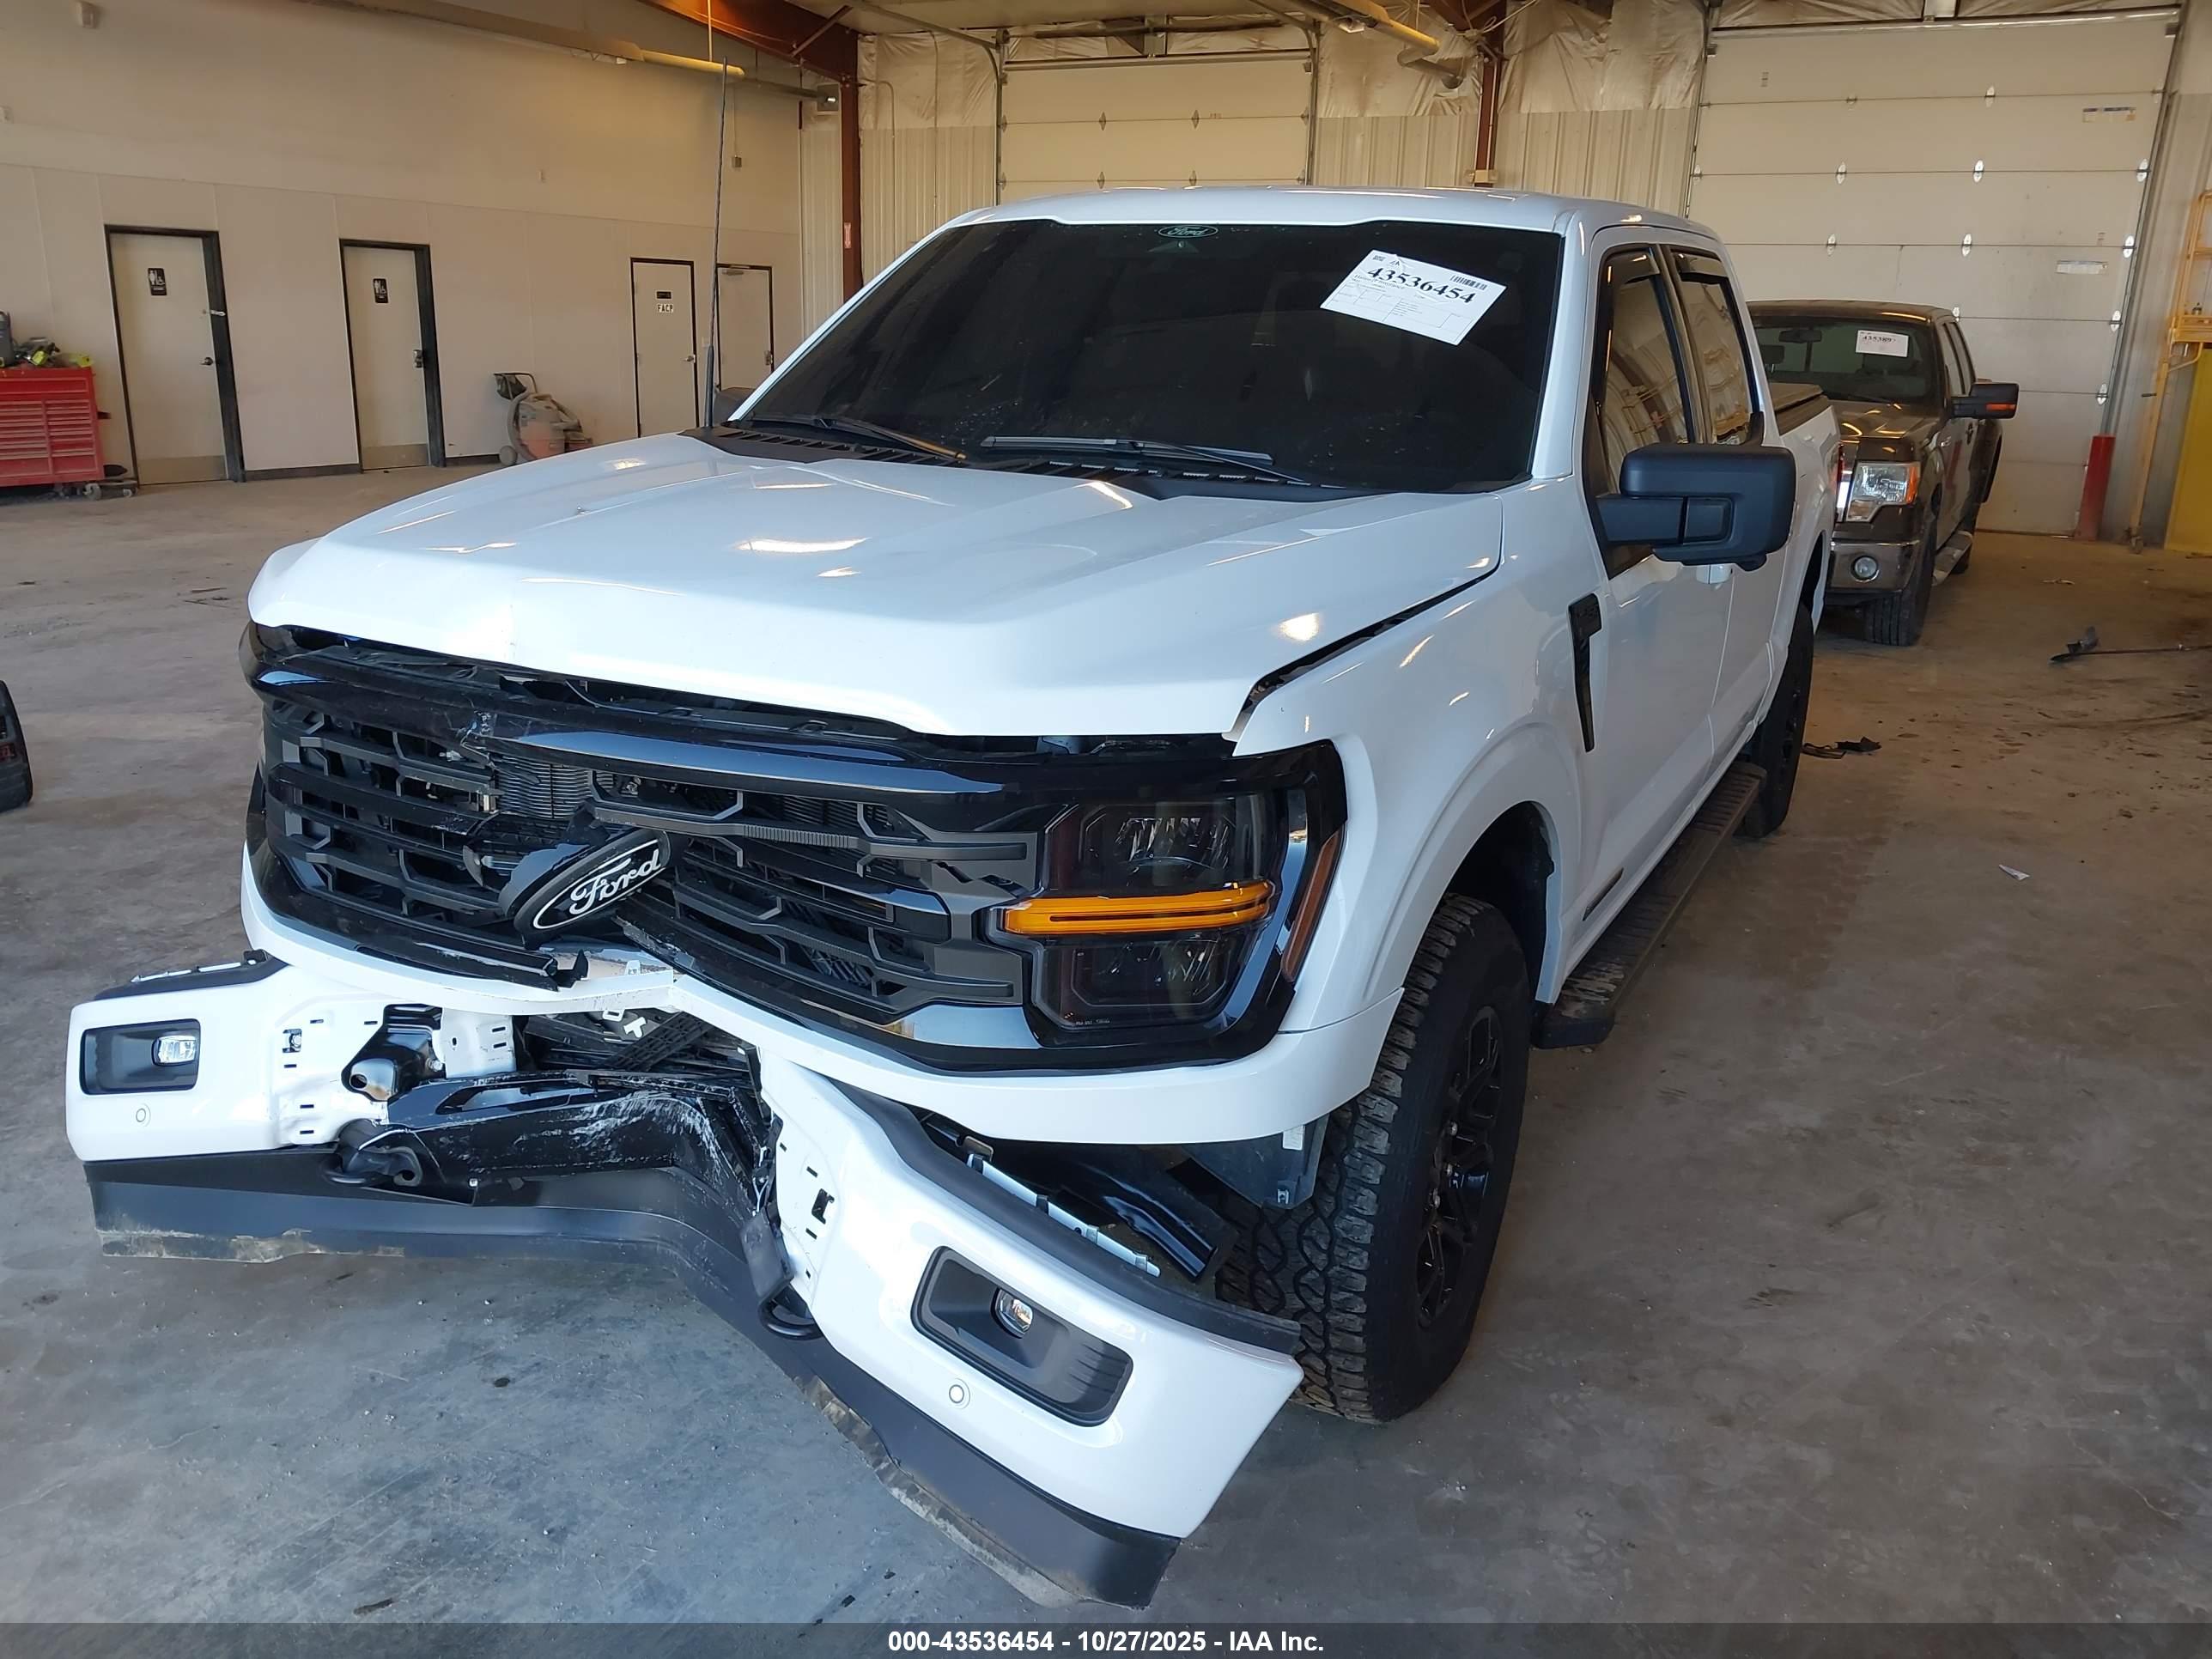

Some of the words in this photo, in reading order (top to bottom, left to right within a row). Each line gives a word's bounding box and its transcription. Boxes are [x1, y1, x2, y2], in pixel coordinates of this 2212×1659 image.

[1167, 226, 1209, 236] Ford
[1367, 266, 1476, 304] 43536454
[569, 848, 661, 915] Ford
